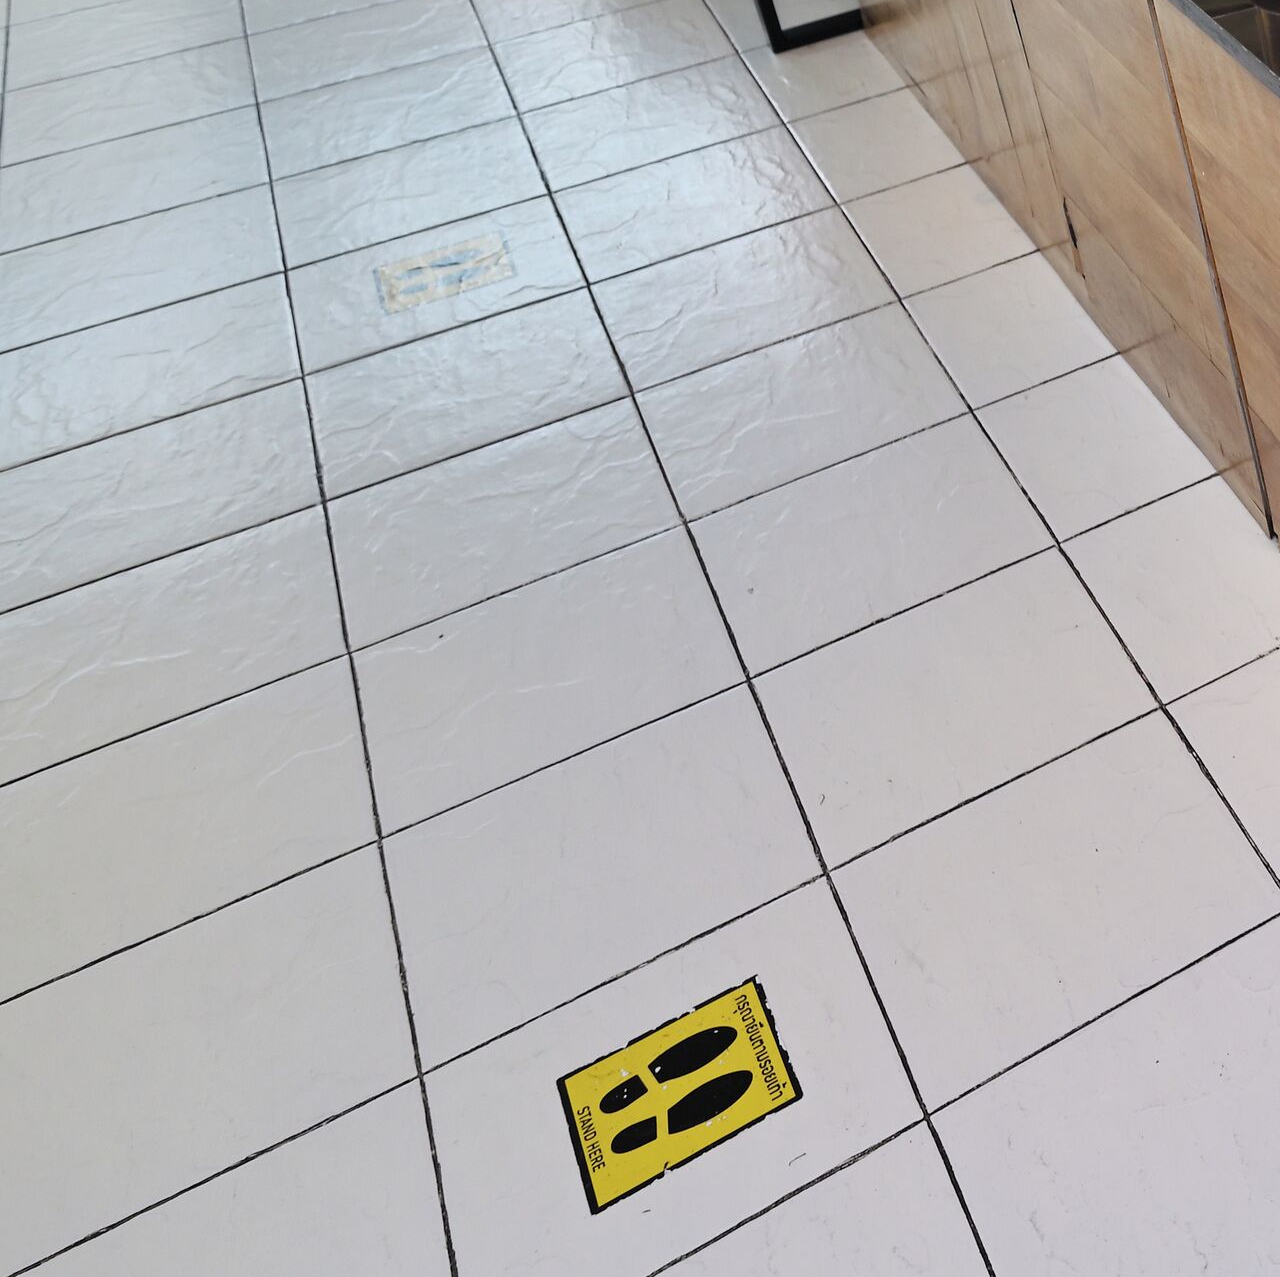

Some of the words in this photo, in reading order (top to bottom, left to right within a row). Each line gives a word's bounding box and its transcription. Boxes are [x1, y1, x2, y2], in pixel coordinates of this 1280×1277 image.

[733, 994, 788, 1102] กรุณายืนตามรอยเท้า
[577, 1105, 597, 1142] STAND
[586, 1140, 606, 1173] HERE
